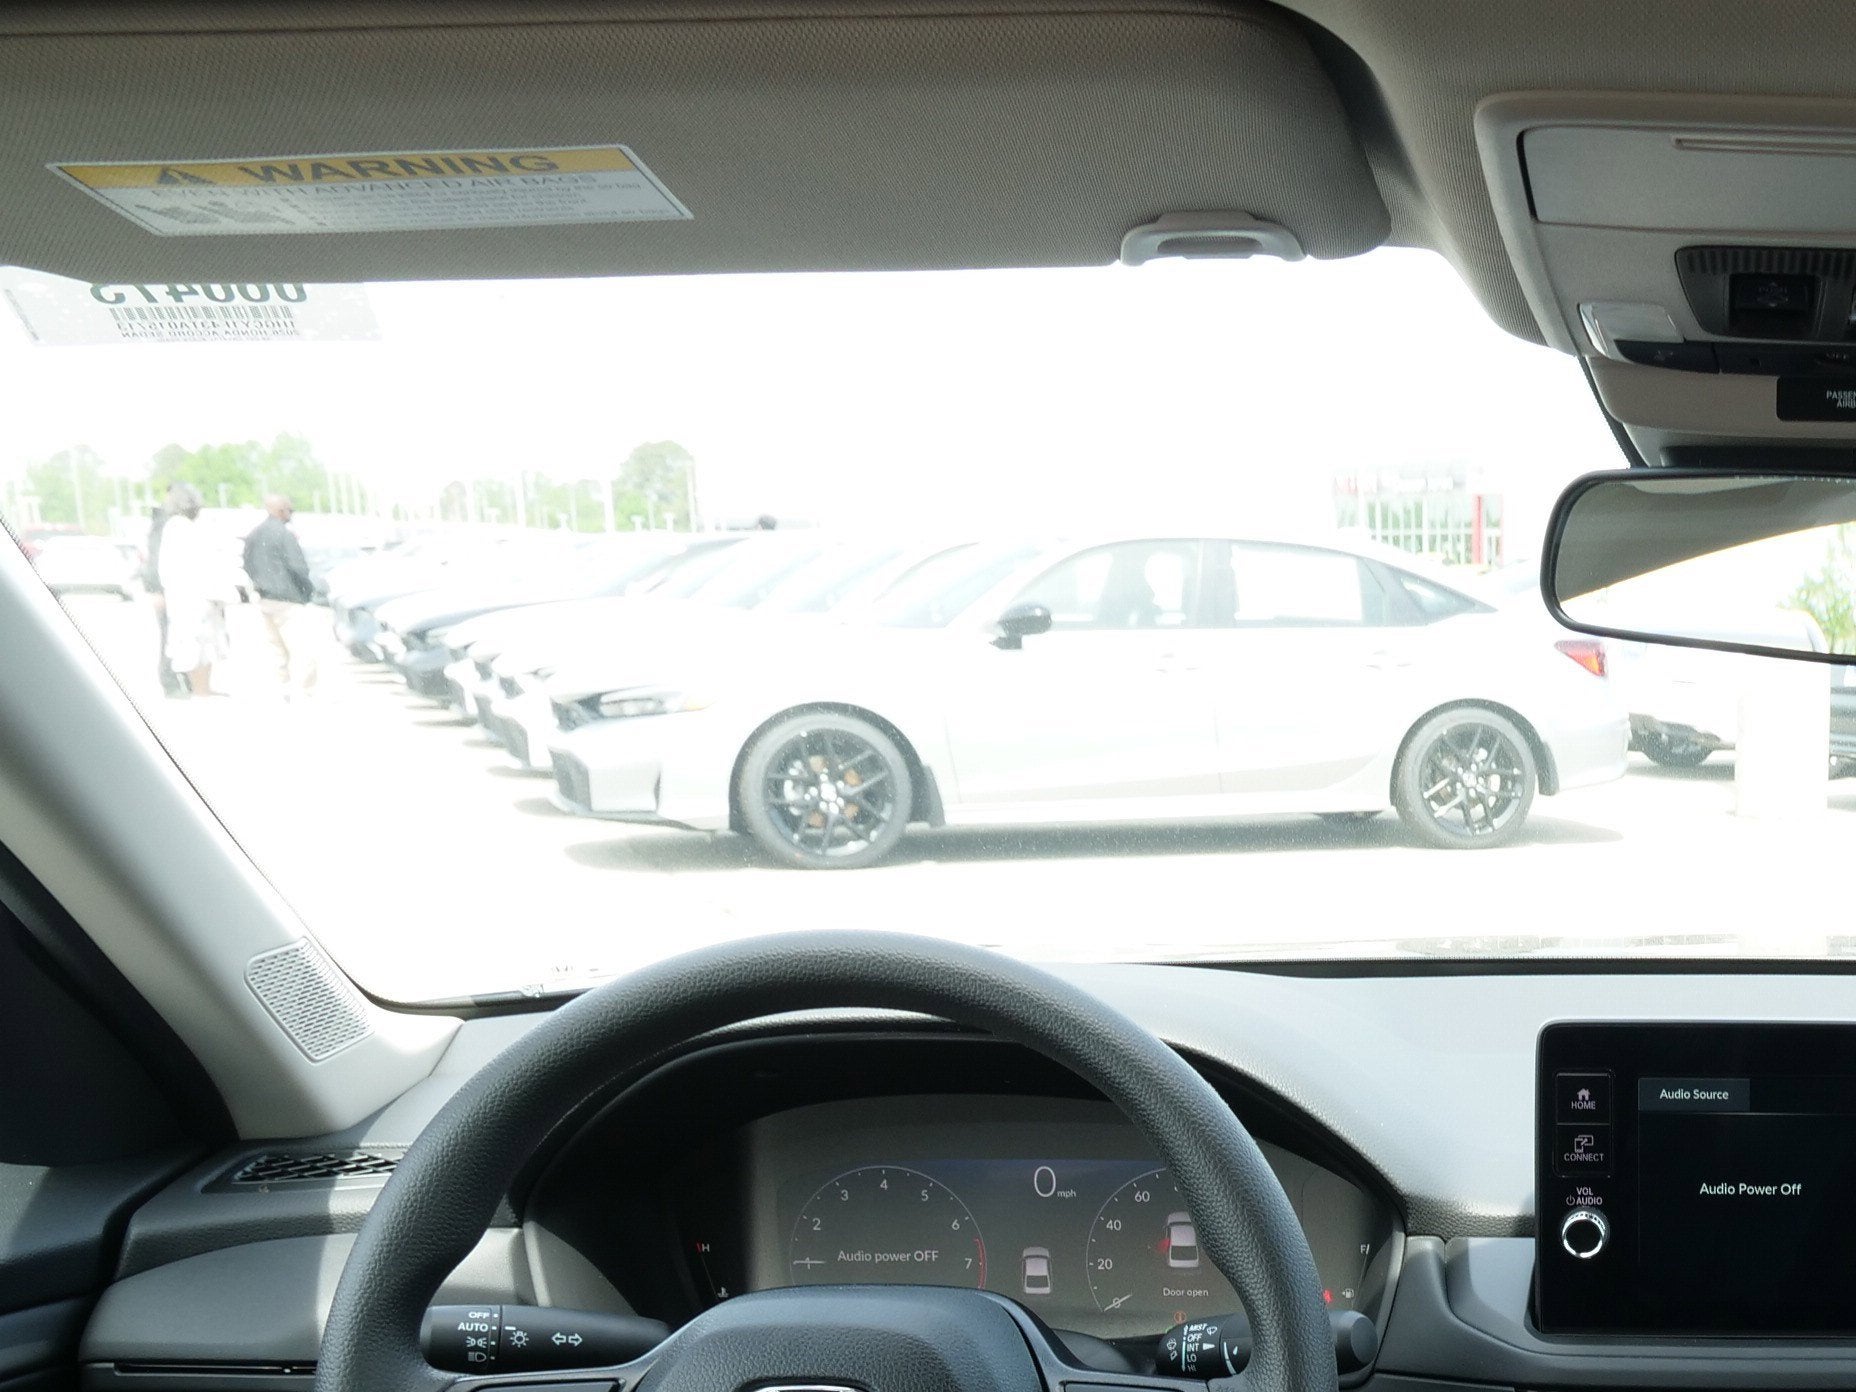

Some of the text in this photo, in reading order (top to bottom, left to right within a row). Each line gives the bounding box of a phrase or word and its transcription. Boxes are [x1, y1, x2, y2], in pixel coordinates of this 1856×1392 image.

[237, 154, 561, 182] WARNING
[1659, 1089, 1731, 1100] Audio Source
[1571, 1101, 1596, 1110] HOME
[1563, 1153, 1604, 1162] CONNECT
[880, 1178, 889, 1191] 4
[1034, 1166, 1056, 1197] 0
[1576, 1187, 1594, 1196] VOL
[1700, 1182, 1802, 1196] Audio Power Off
[840, 1189, 849, 1201] 3
[920, 1189, 929, 1202] 5
[1134, 1191, 1150, 1203] 60
[1576, 1196, 1603, 1205] AUDIO
[812, 1218, 821, 1231] 2
[951, 1218, 960, 1231] 6
[1106, 1220, 1121, 1231] 40
[837, 1250, 939, 1265] Audio power OFF
[964, 1257, 972, 1270] 7
[1097, 1258, 1112, 1270] 20
[1163, 1288, 1208, 1299] Door open
[468, 1311, 490, 1319] OFF
[458, 1323, 489, 1331] AUTO
[1188, 1334, 1202, 1342] OFF
[1187, 1343, 1199, 1351] INT
[1187, 1353, 1197, 1362] LO
